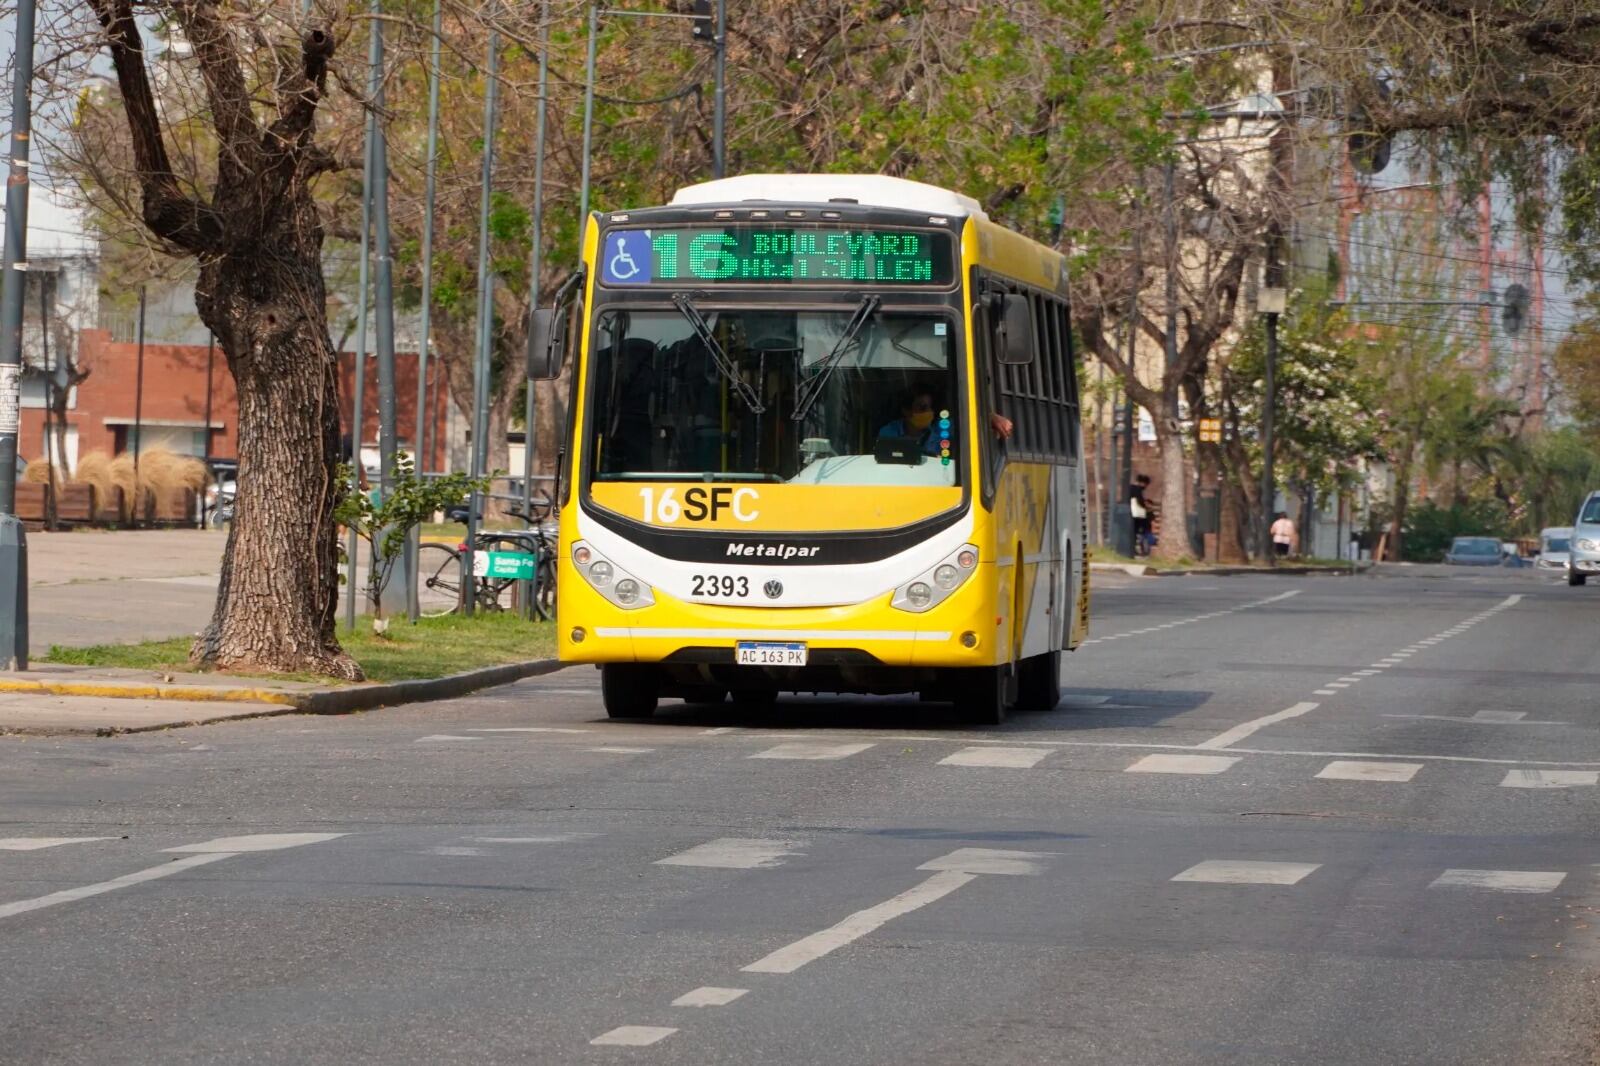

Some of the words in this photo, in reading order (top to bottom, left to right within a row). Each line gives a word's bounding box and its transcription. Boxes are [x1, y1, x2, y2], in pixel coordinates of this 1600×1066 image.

[753, 234, 919, 256] BOULEVARD
[652, 234, 739, 278] 16
[726, 543, 820, 560] Metalpar
[494, 557, 521, 567] Santa
[691, 575, 749, 598] 2393
[741, 650, 757, 663] AC
[760, 650, 784, 663] 163
[788, 651, 803, 664] PK
